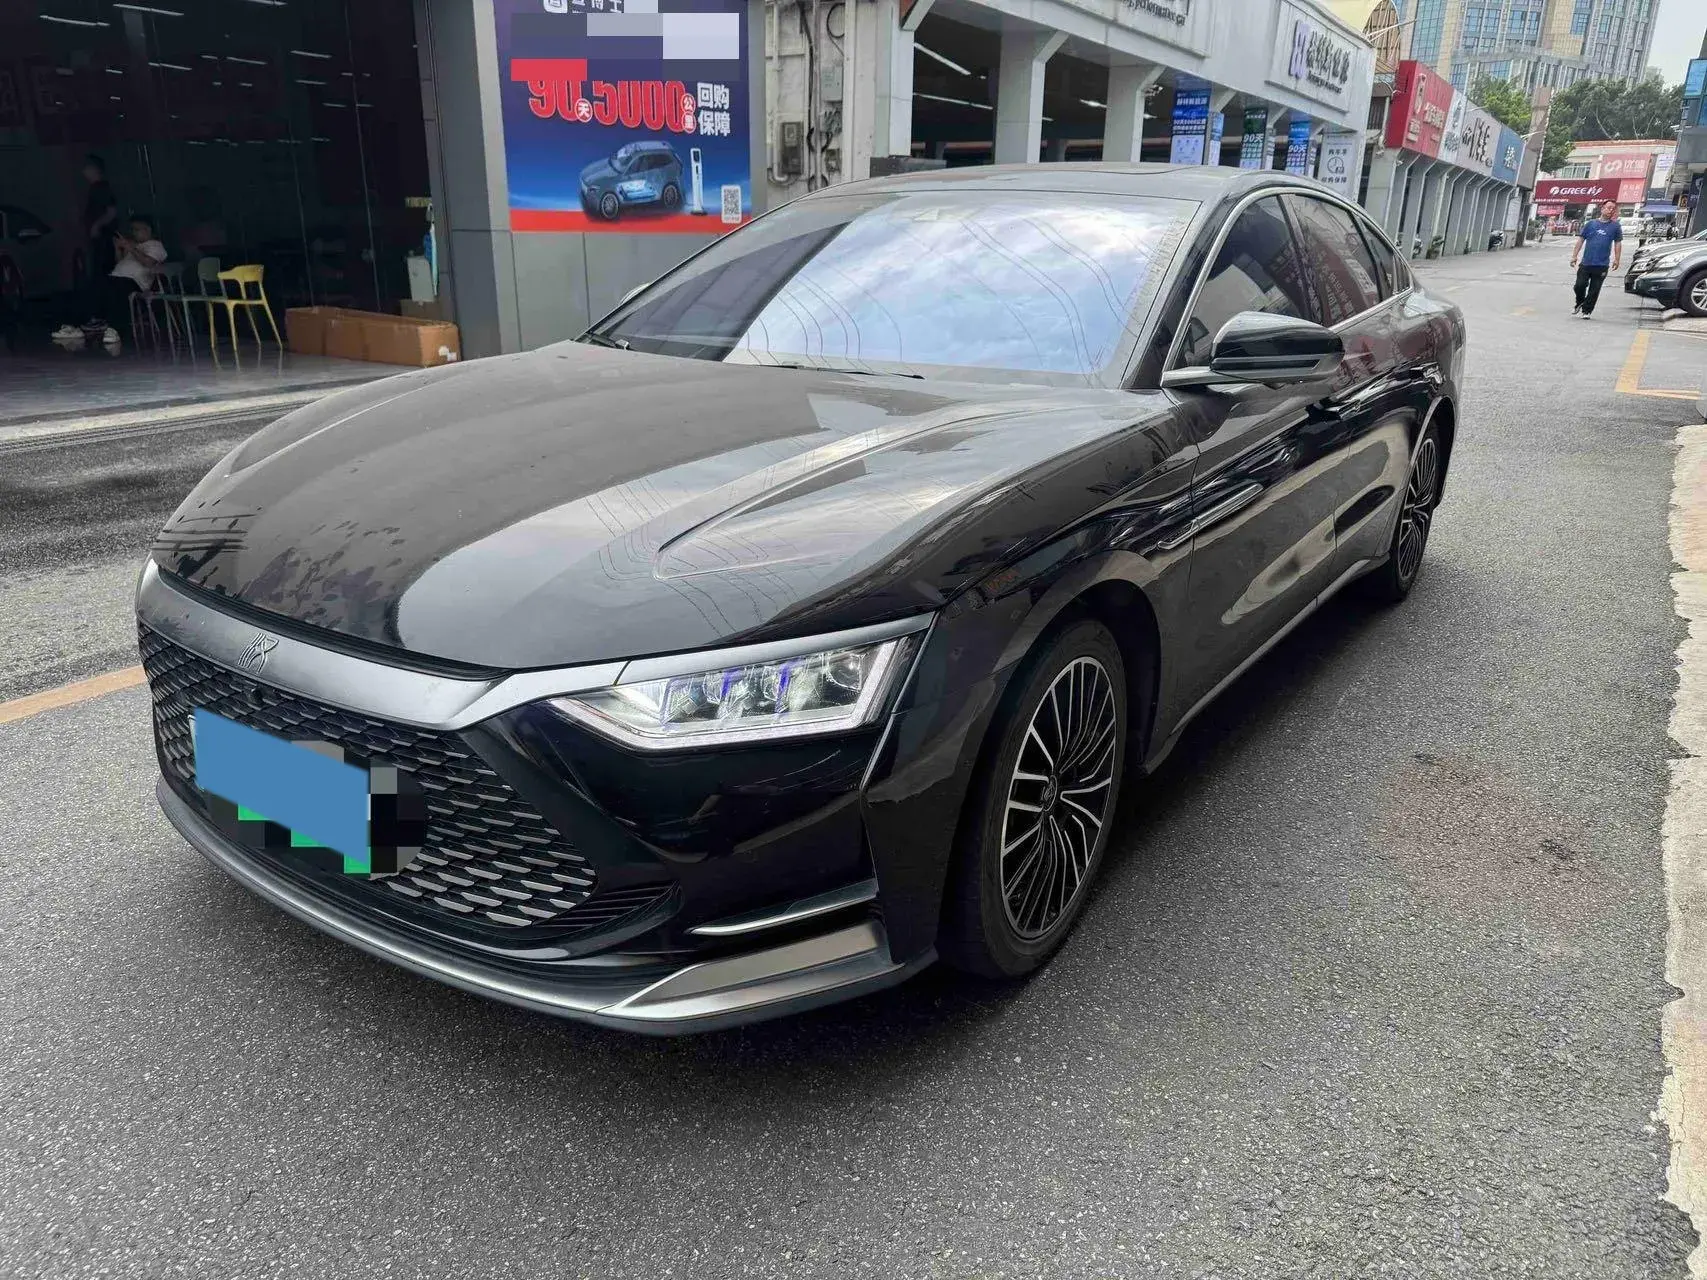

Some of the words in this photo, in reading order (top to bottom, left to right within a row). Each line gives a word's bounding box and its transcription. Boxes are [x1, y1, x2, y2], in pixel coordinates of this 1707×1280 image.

[697, 82, 730, 110] 回购
[698, 111, 731, 136] 保障
[1560, 187, 1587, 196] GREE
